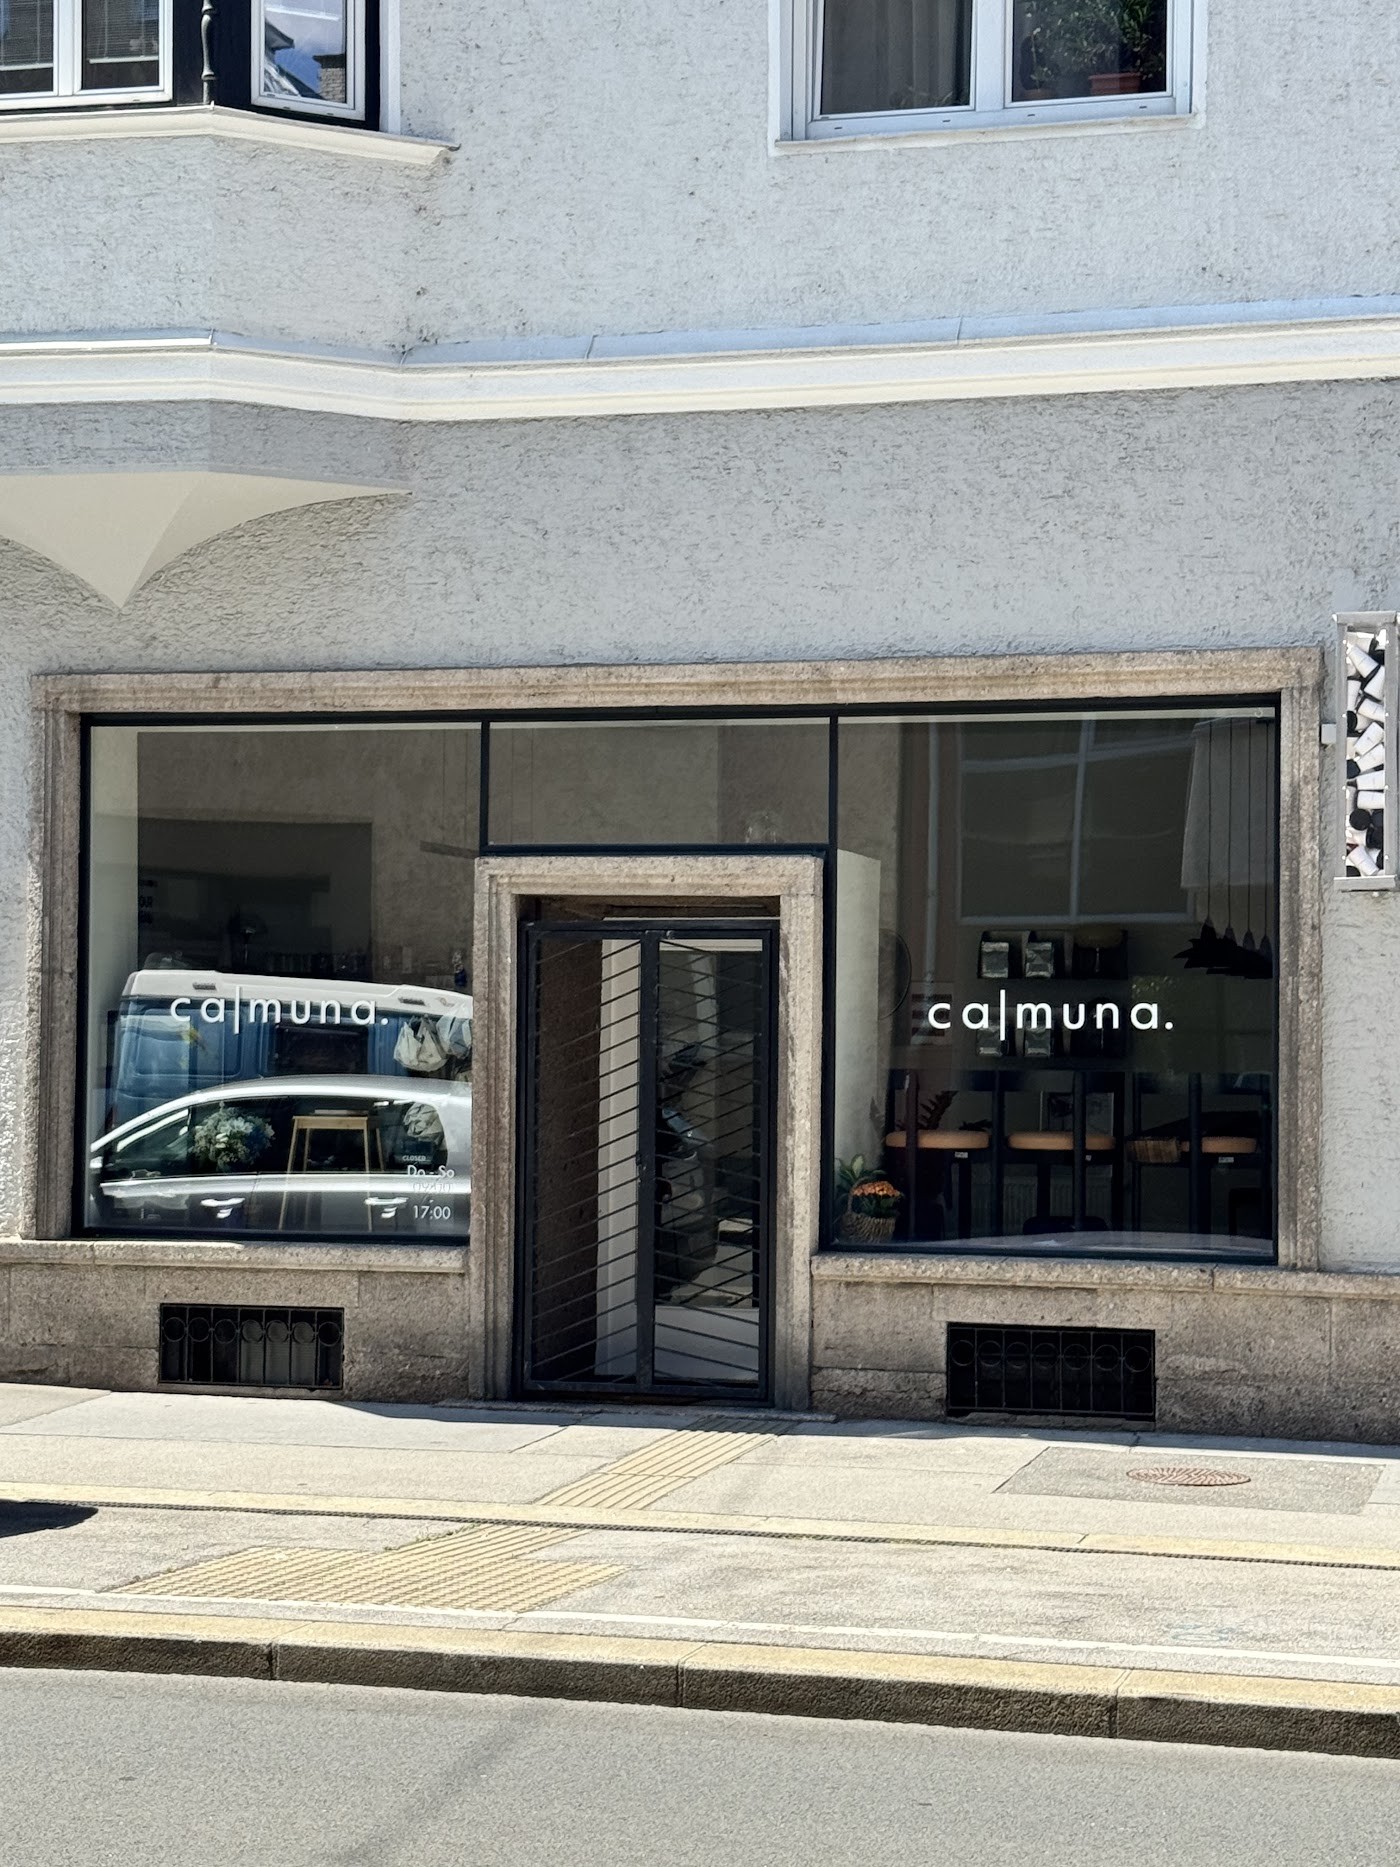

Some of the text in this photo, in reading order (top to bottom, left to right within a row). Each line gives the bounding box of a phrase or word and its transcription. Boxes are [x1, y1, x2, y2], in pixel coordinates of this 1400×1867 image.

[407, 1164, 426, 1177] Do
[438, 1164, 455, 1178] So
[413, 1205, 451, 1219] 17:00
